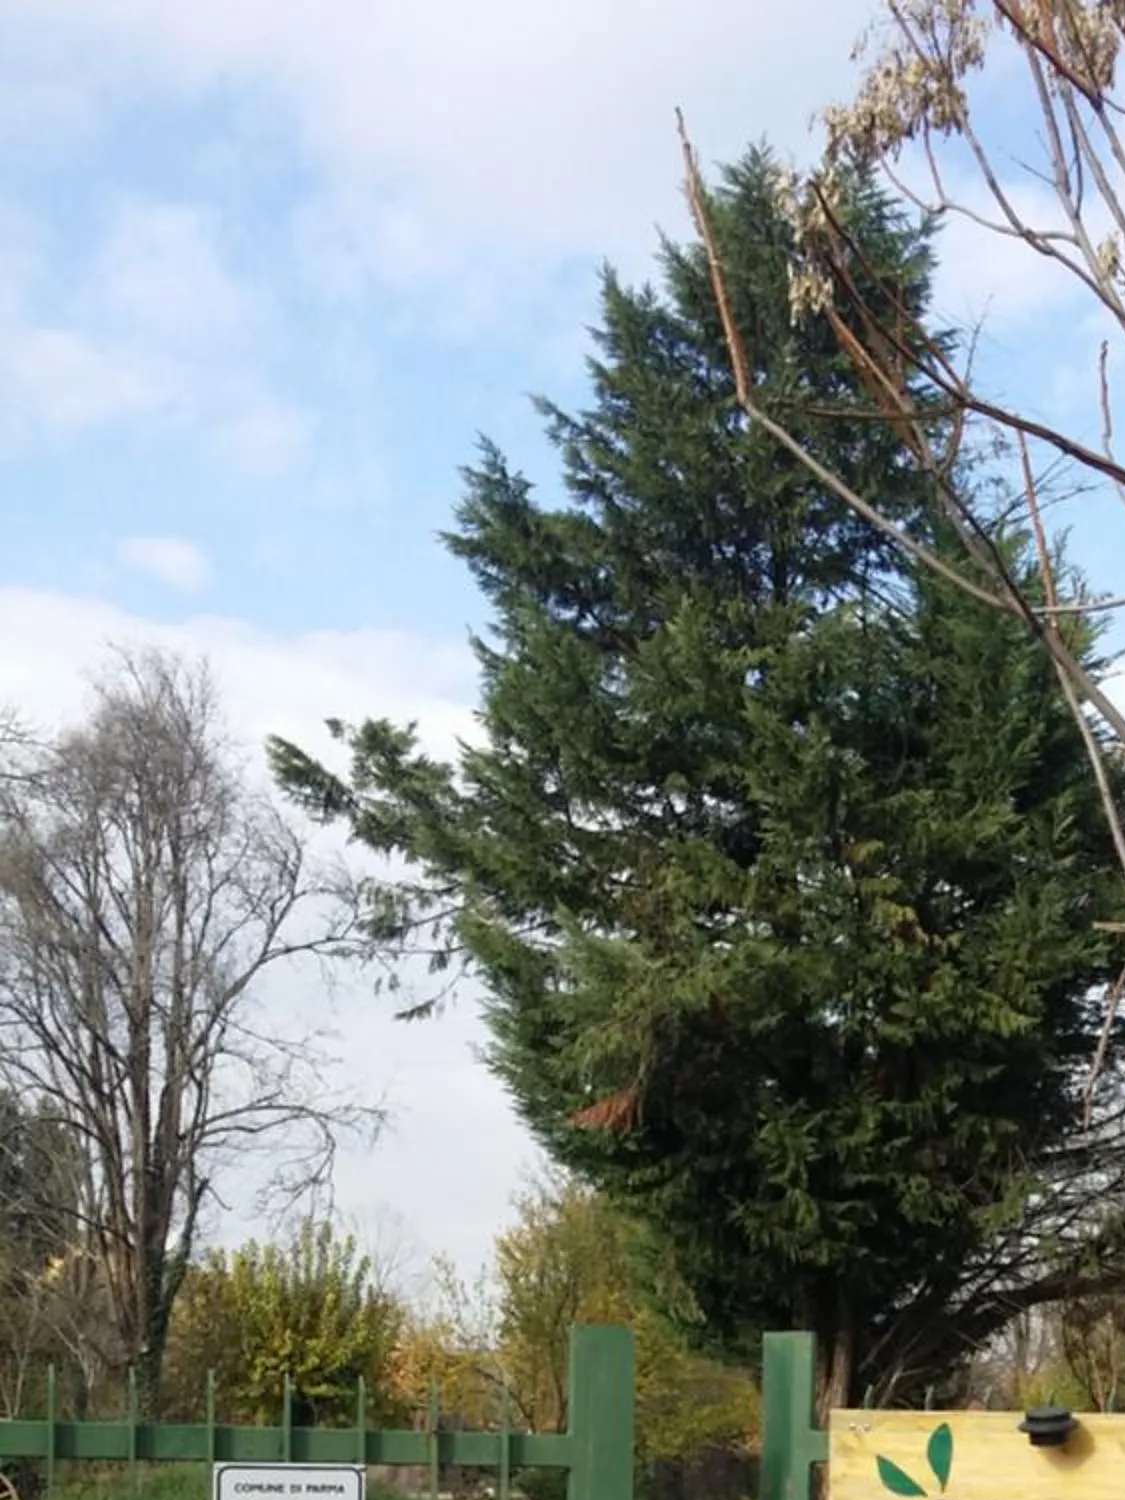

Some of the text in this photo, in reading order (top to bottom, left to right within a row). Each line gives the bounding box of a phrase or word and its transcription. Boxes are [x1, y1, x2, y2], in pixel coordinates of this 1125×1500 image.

[234, 1483, 345, 1494] COMUNE DI PARMA
